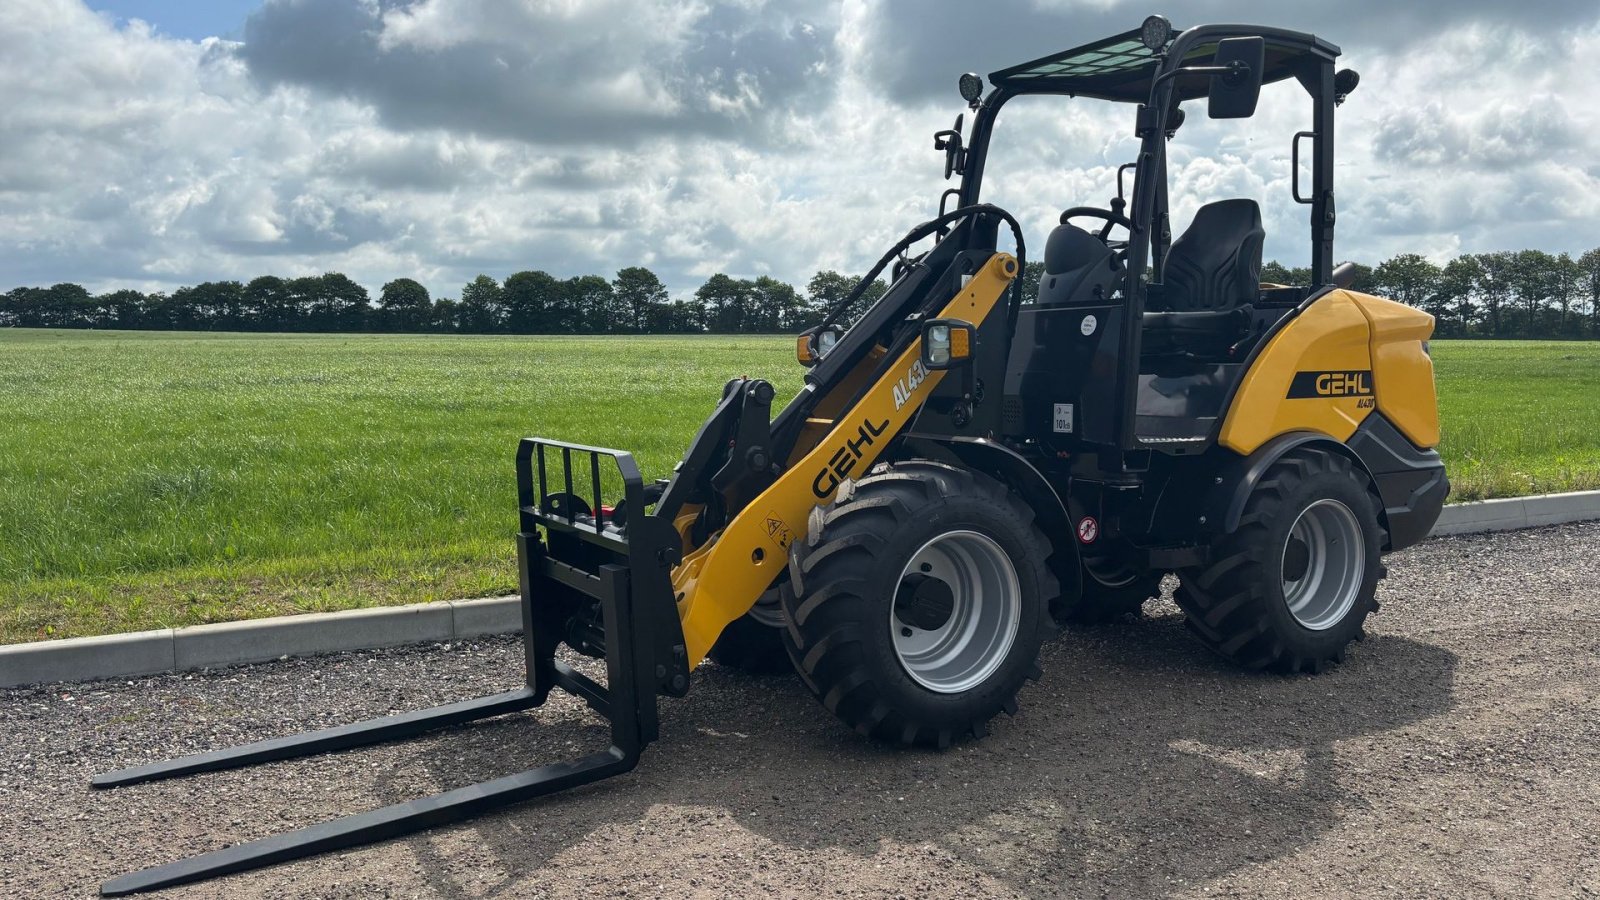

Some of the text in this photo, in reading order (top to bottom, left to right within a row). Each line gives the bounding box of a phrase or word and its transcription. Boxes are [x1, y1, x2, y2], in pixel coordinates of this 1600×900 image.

[1315, 373, 1371, 395] GEHL
[1356, 398, 1374, 409] AL430
[812, 418, 890, 499] GEHL
